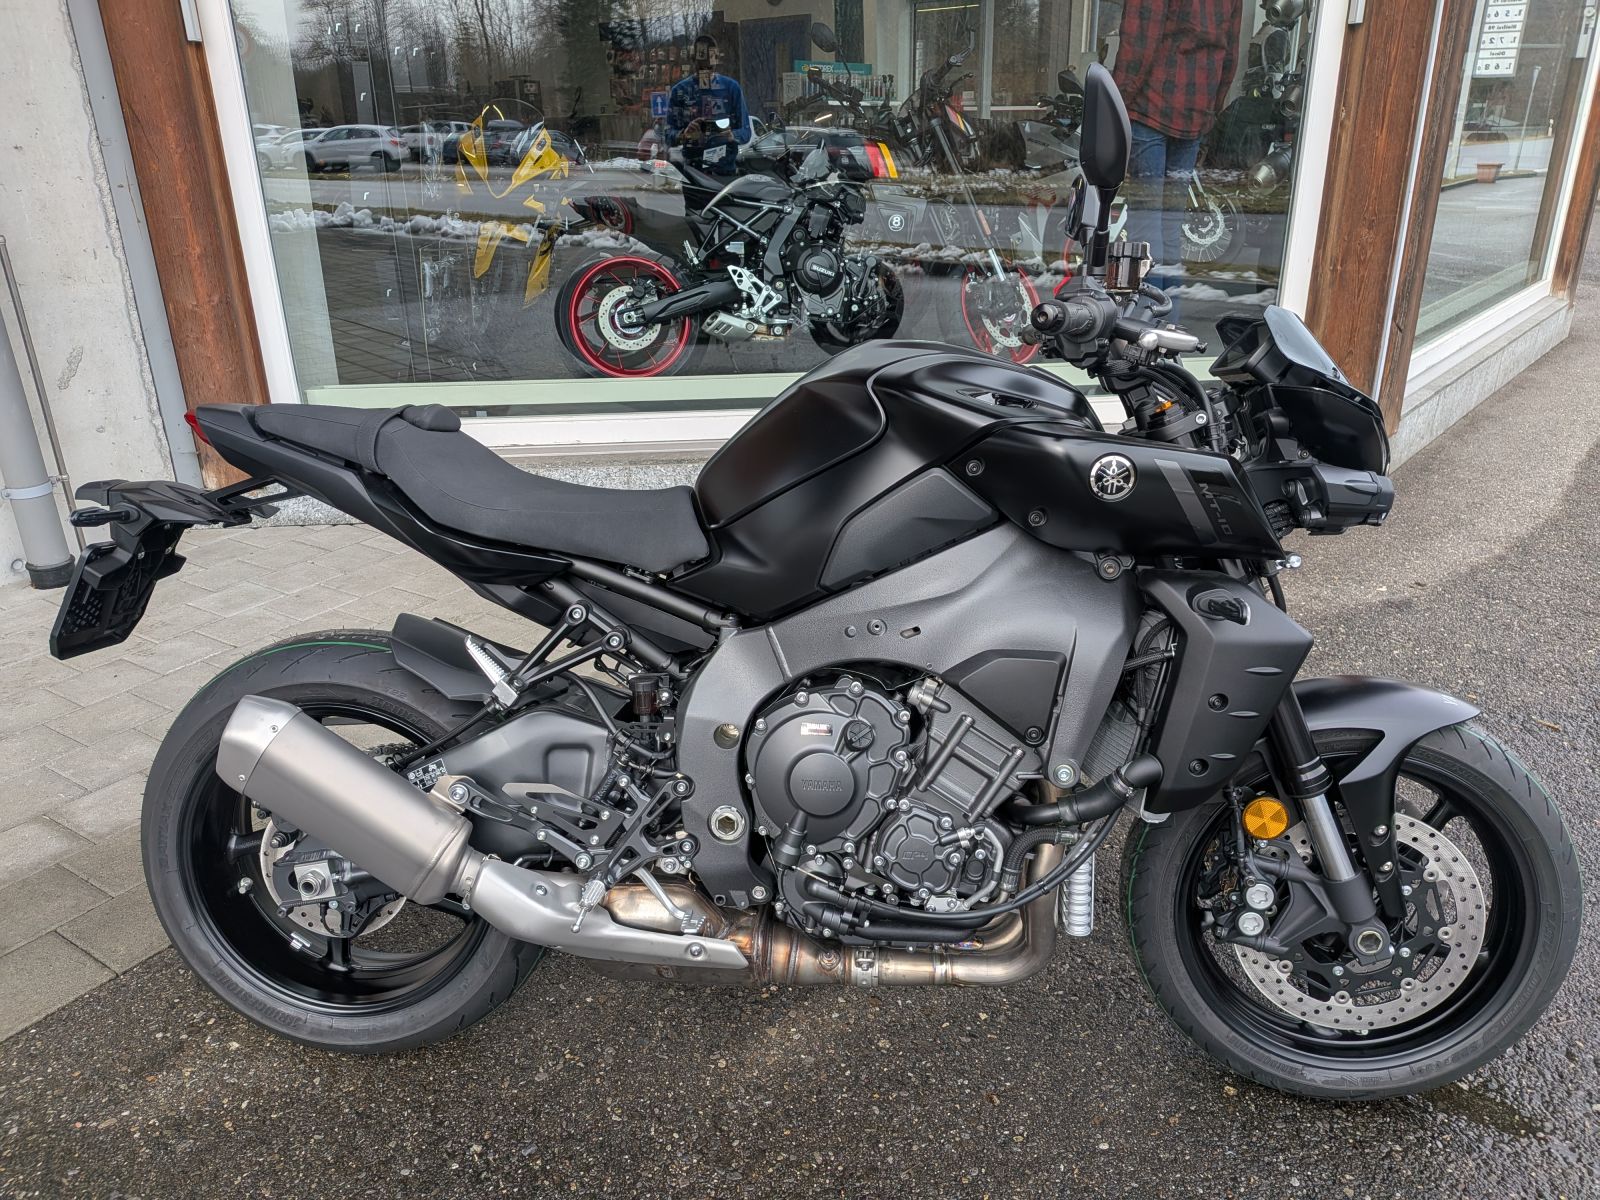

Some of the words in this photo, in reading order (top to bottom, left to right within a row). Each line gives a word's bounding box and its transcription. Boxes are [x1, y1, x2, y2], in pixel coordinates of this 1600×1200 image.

[810, 263, 836, 278] SUZUKI
[1199, 483, 1233, 535] MT-10
[800, 779, 843, 792] YAMAHA
